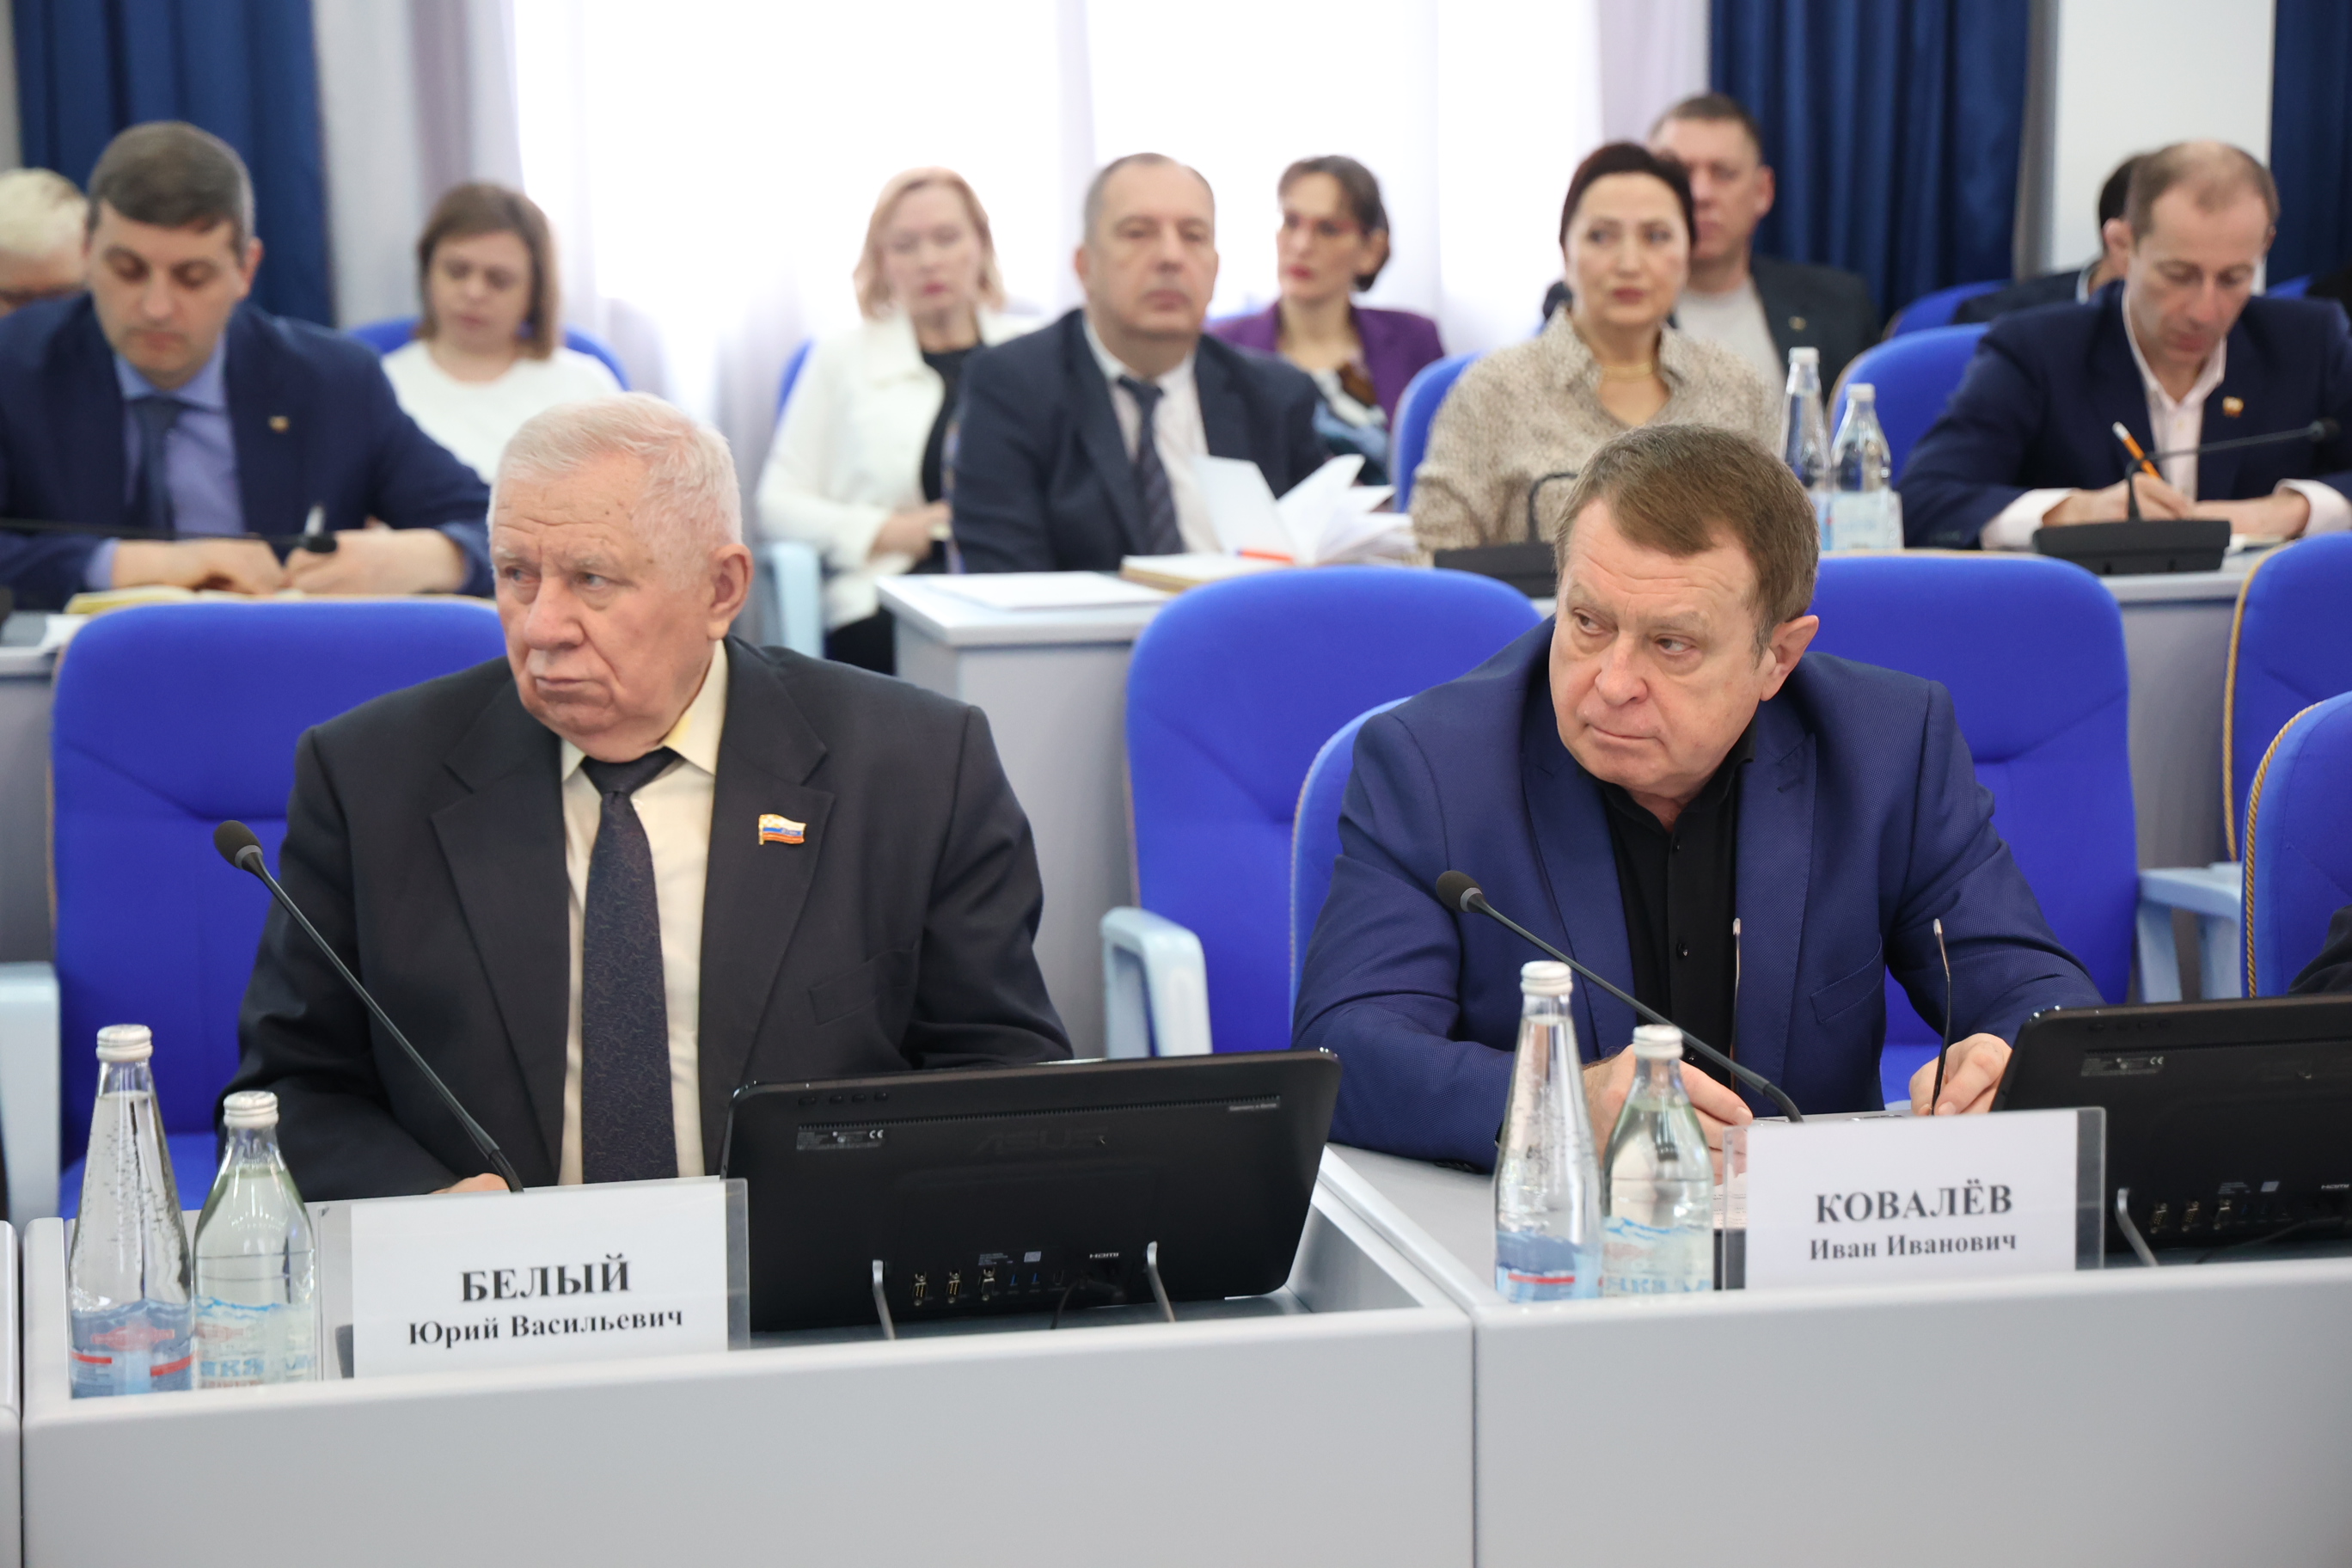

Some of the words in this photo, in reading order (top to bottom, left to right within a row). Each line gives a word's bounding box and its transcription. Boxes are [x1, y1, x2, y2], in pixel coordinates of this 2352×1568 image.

[1815, 1179, 2012, 1223] КОВАЛЁВ
[1810, 1239, 1877, 1260] Иван
[1887, 1234, 2017, 1256] Иванович
[459, 1253, 632, 1302] БЕЛЫЙ
[409, 1317, 499, 1349] Юрий
[511, 1310, 683, 1338] Васильевич
